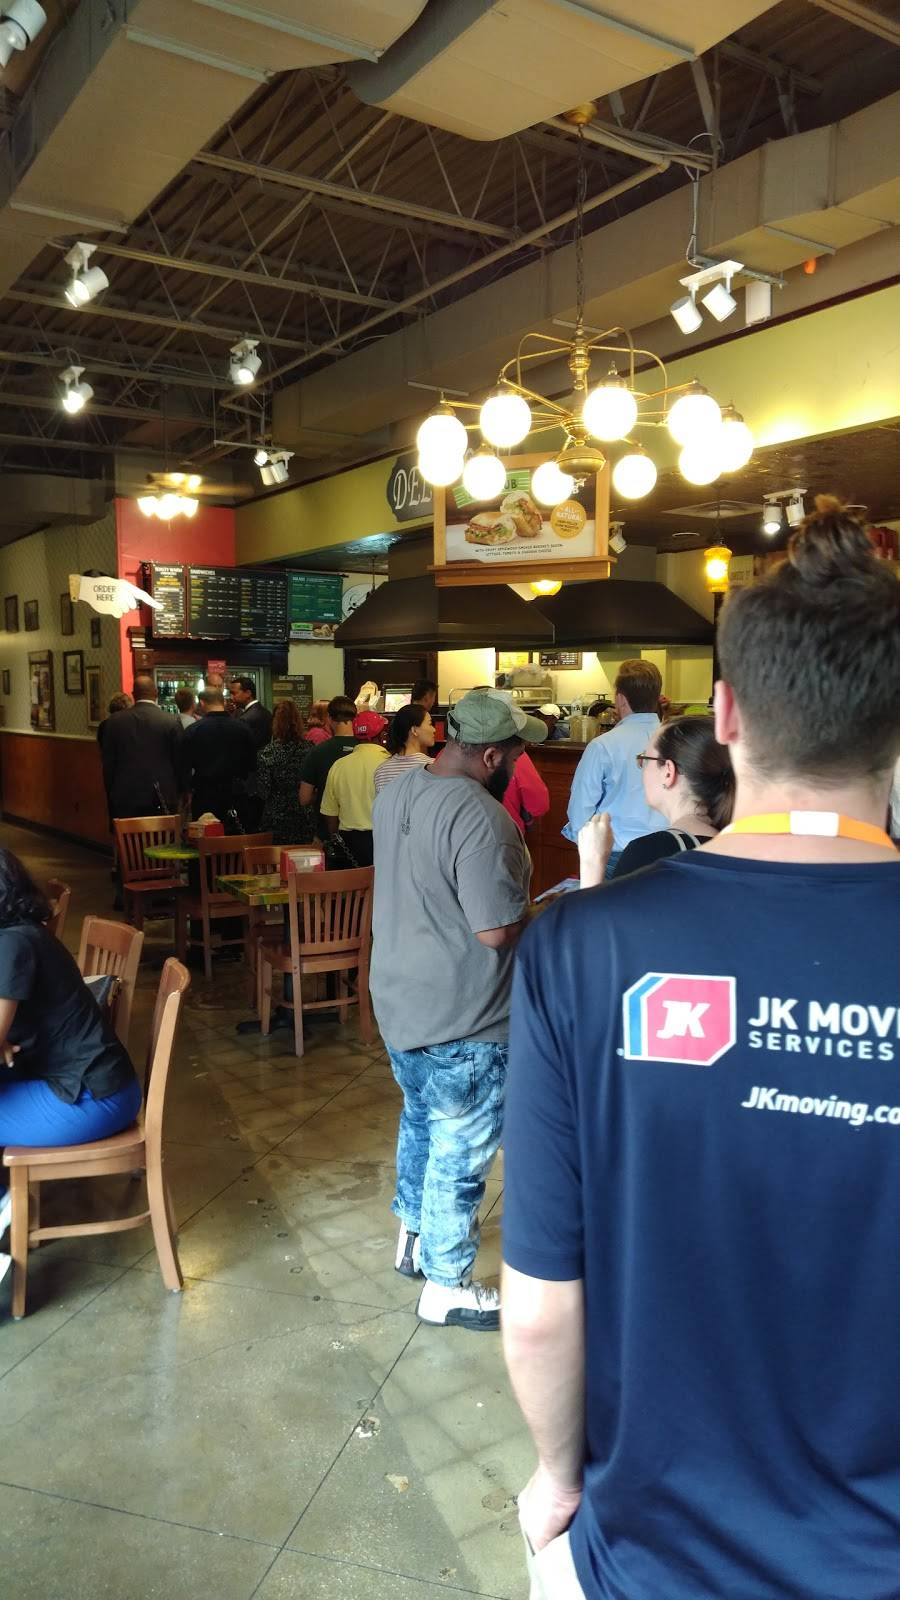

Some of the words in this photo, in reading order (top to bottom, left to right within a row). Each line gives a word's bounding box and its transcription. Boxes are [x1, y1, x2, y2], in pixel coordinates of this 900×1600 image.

[93, 584, 116, 593] ORDER
[96, 593, 115, 602] HERE
[656, 1000, 711, 1039] JK
[748, 996, 799, 1031] JK
[748, 1031, 895, 1061] SERVICES
